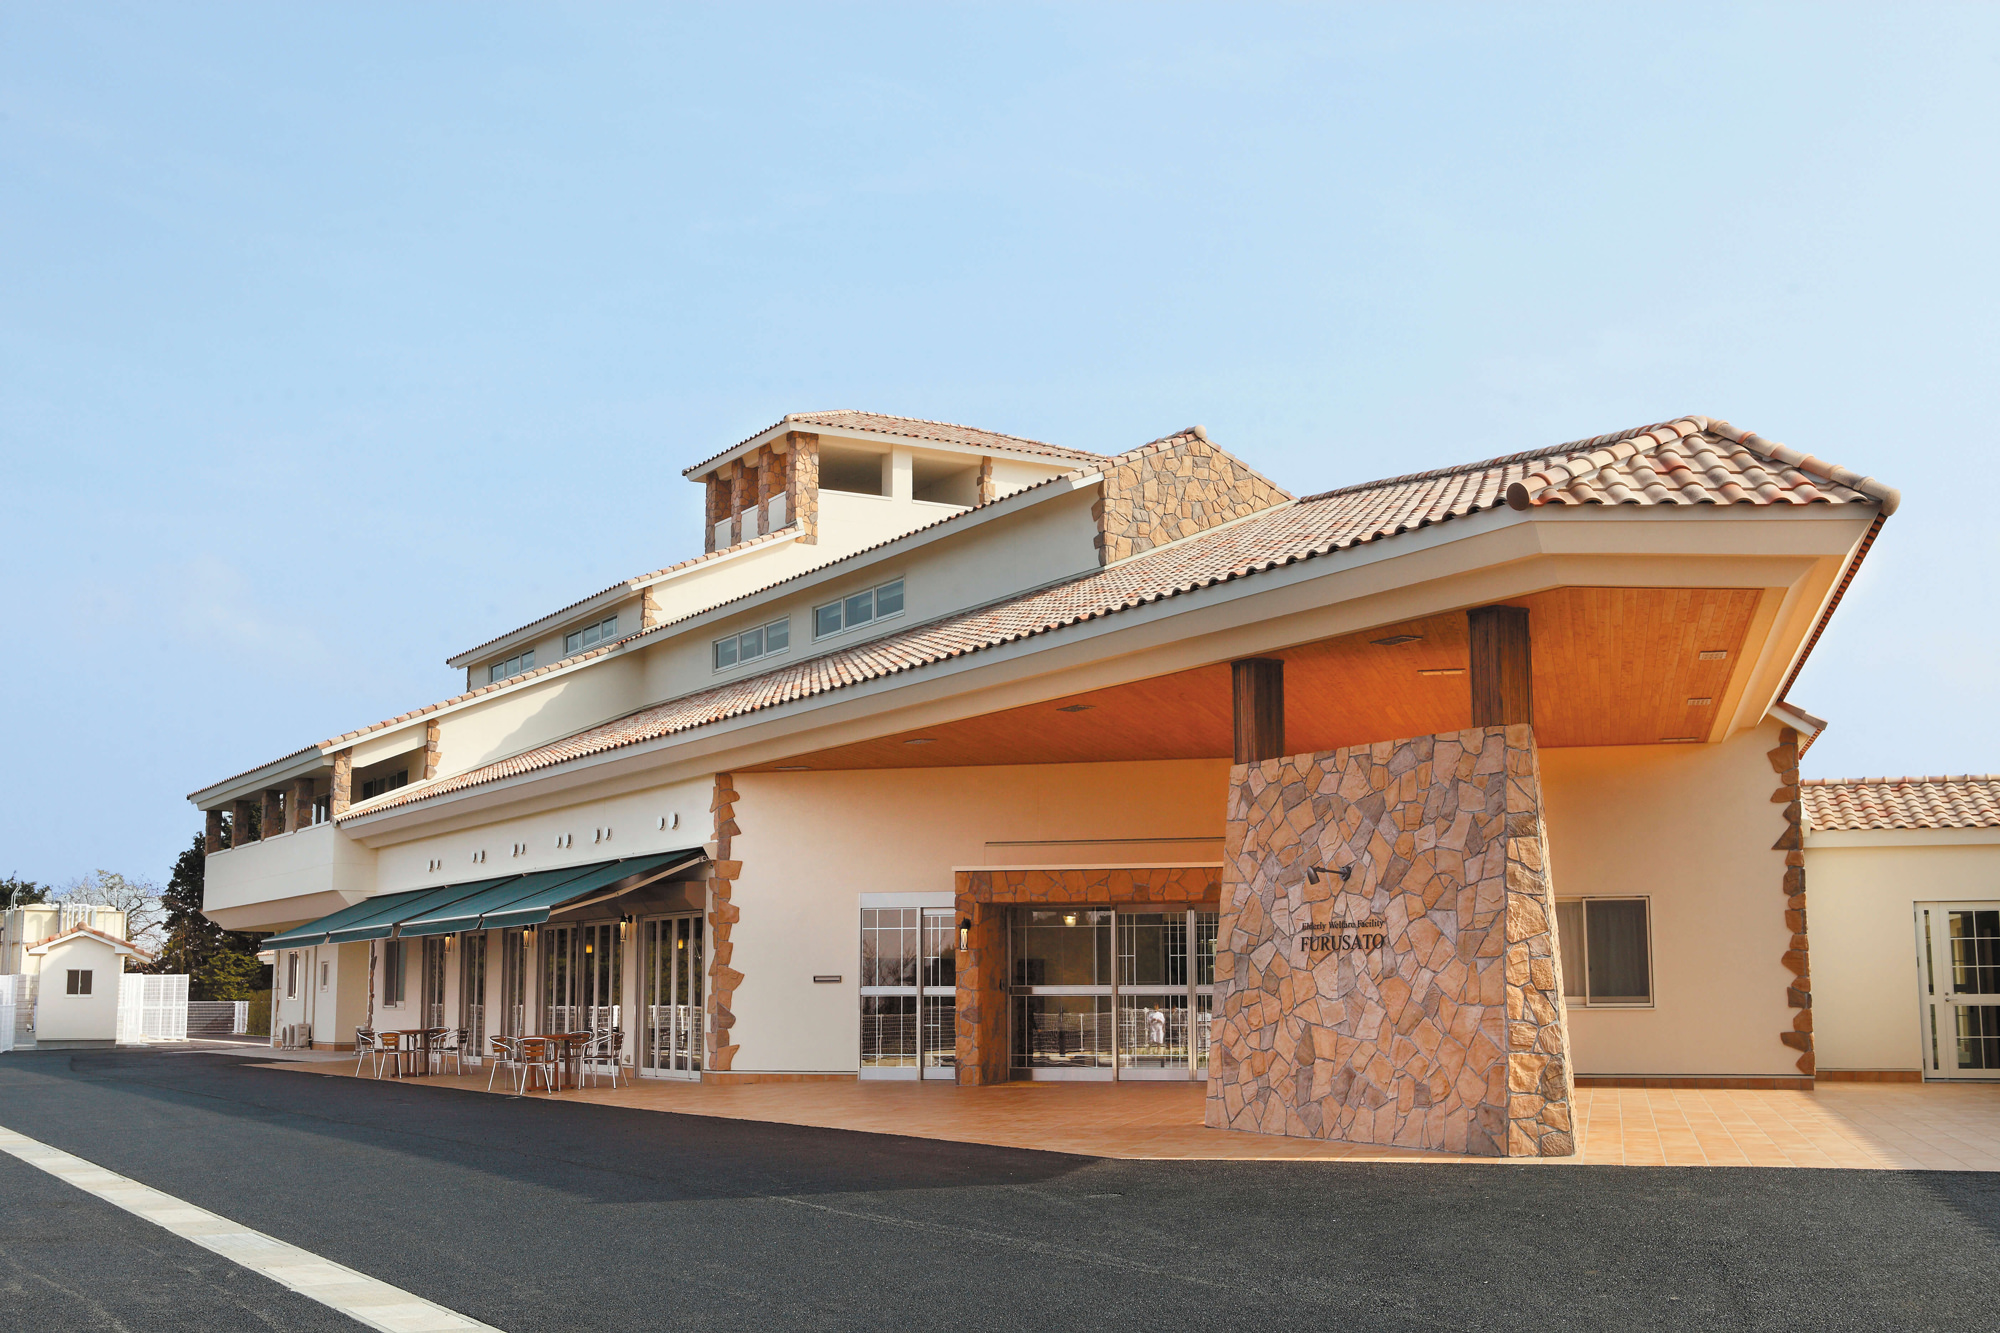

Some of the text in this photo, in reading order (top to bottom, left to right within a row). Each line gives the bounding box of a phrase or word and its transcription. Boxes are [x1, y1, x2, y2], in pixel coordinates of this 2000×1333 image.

[1302, 919, 1384, 931] Elderly Welfare Facility
[1300, 933, 1384, 952] FURUSATO
